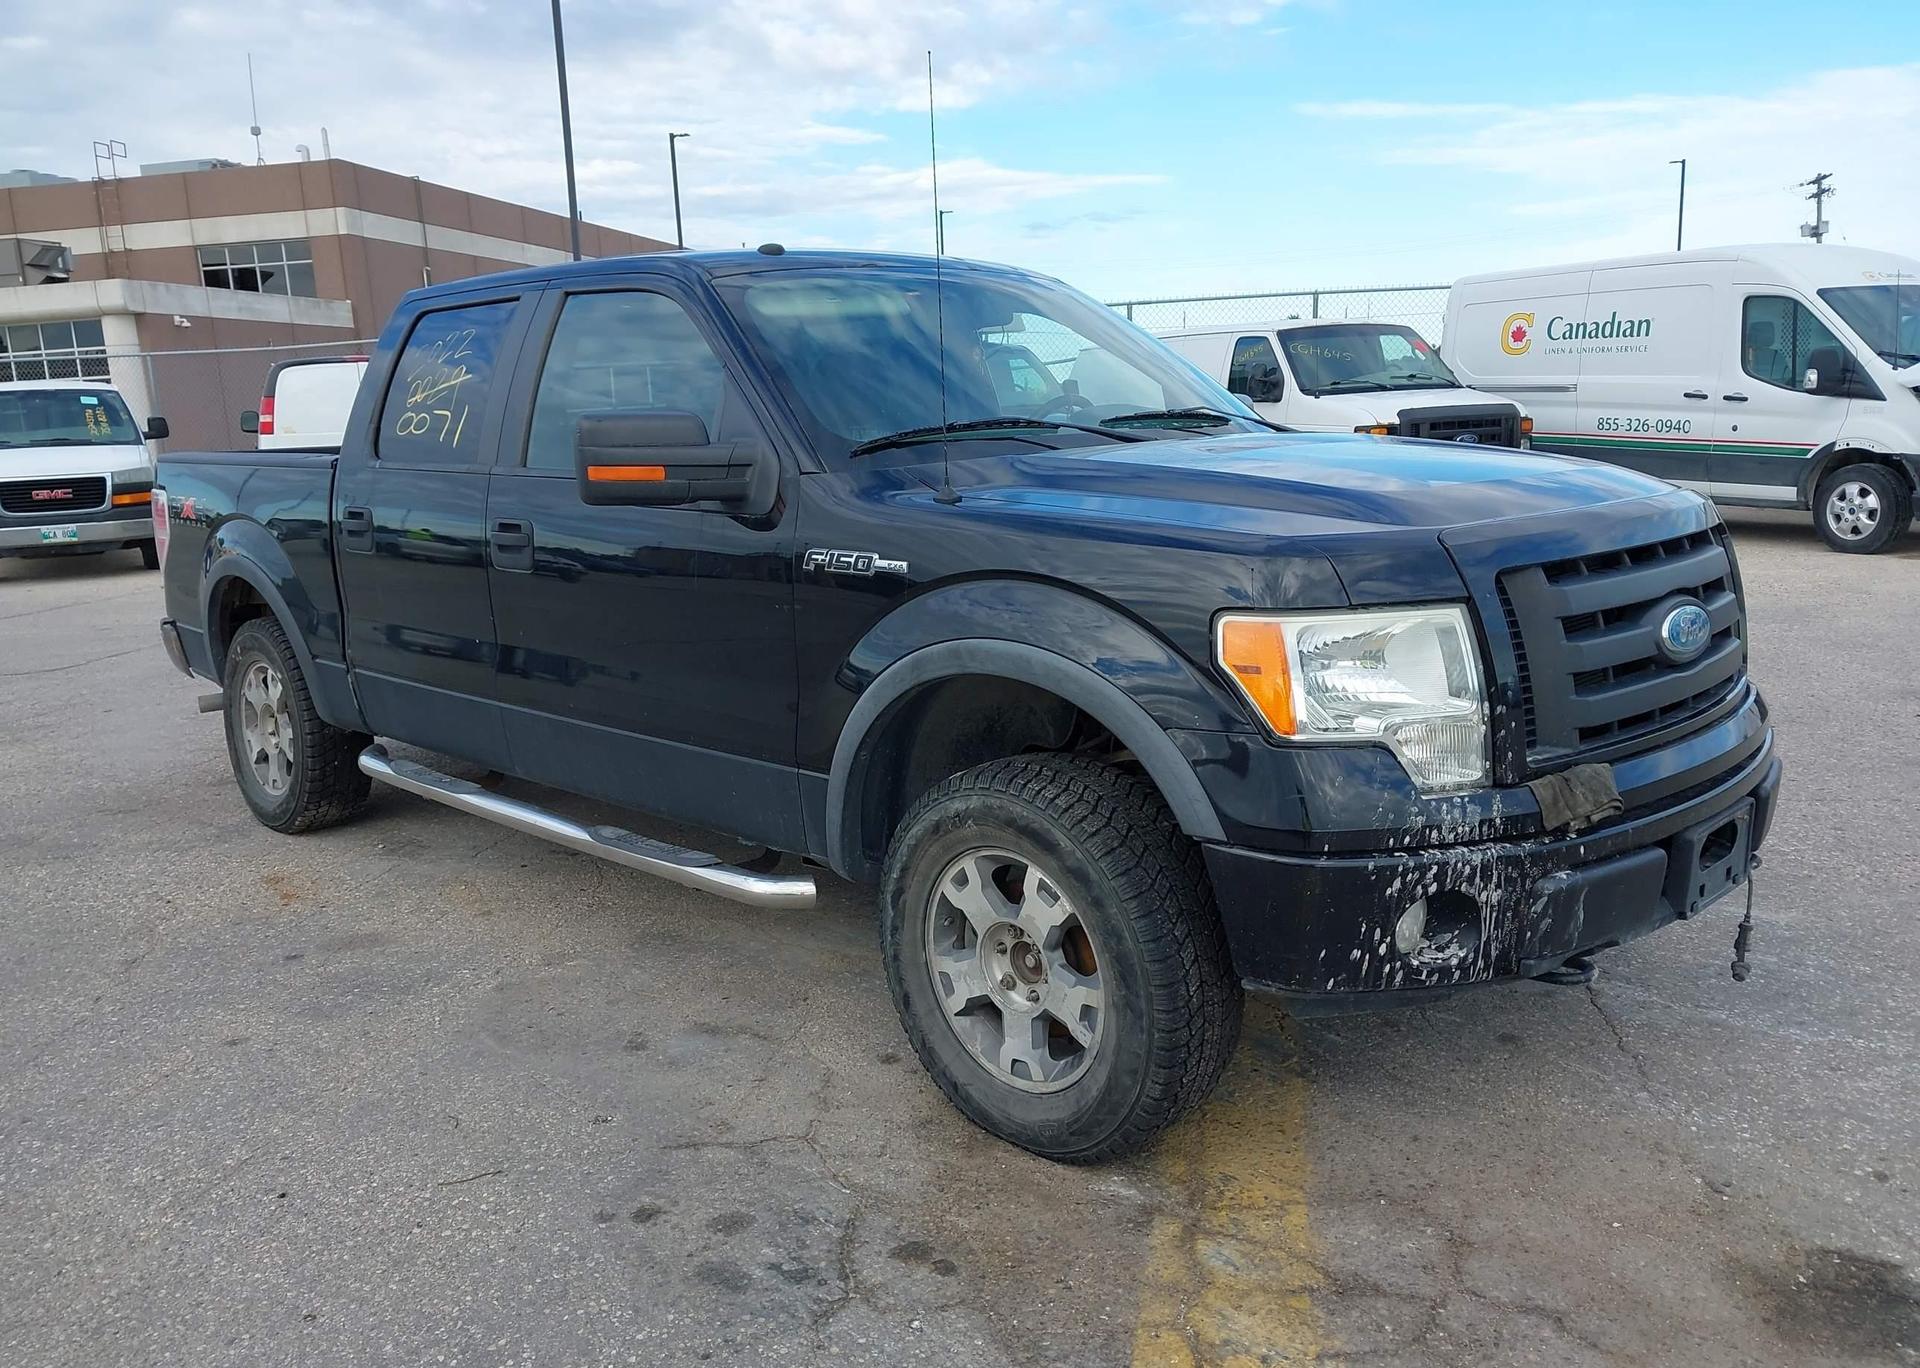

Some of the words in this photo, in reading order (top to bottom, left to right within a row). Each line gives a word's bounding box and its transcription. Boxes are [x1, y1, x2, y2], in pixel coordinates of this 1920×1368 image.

[1547, 311, 1651, 341] Canadian
[1544, 347, 1567, 355] LINEN
[1568, 346, 1573, 354] &
[1576, 345, 1613, 354] UNIFORM
[1615, 344, 1648, 353] SERVICE
[396, 404, 469, 448] 0071
[1597, 416, 1692, 434] 855-326-0940
[32, 489, 72, 500] GMC
